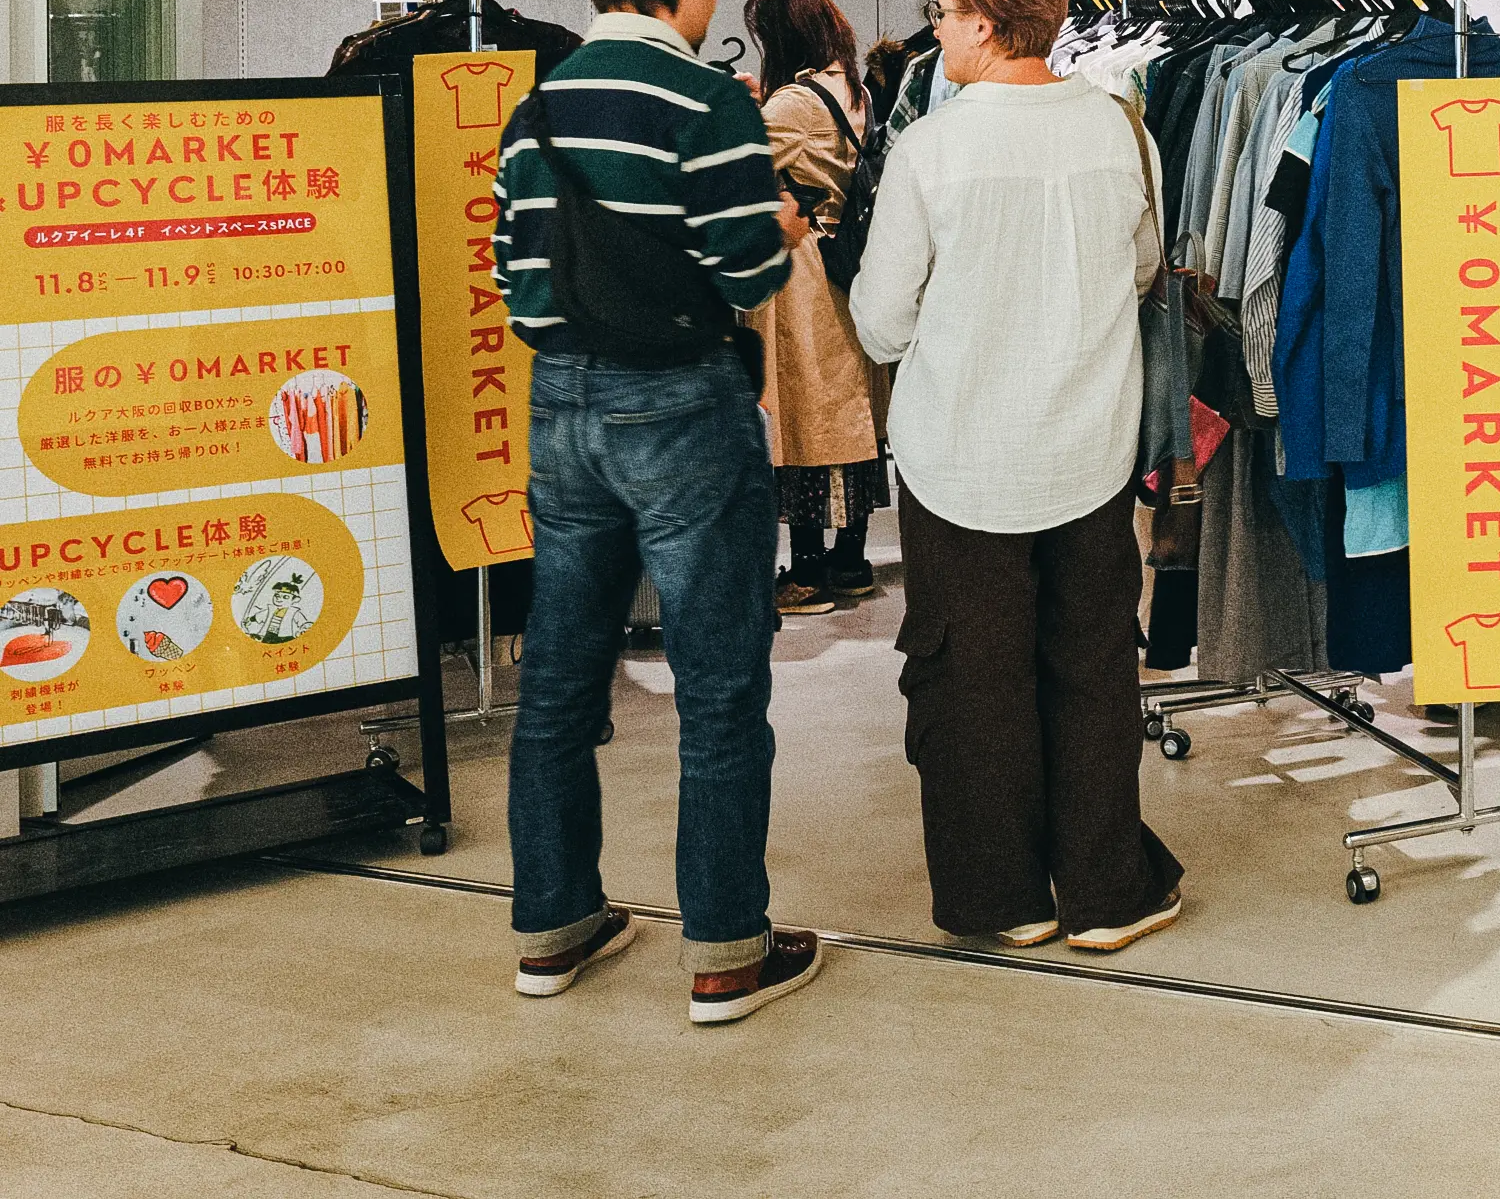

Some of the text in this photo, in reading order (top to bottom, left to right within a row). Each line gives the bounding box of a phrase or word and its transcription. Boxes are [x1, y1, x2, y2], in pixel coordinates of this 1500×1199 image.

[45, 110, 276, 133] 服を長く楽しむための
[0, 166, 341, 212] UPCYCLE体験
[35, 271, 95, 295] 11.8
[97, 271, 108, 292] SAT
[144, 264, 201, 289] 11.9
[206, 262, 215, 285] SUN
[233, 260, 346, 281] 10:30-17:00
[68, 394, 255, 426] ルクア大阪の回収BOXから
[40, 413, 282, 451] 厳選した洋服を、お一人様2点まで
[83, 442, 242, 470] 無料でお持ち帰りOK！
[0, 513, 268, 571] UPCYCLE体験
[0, 538, 312, 589] ッペンや刺繍などで可愛くアップデート体験をご用意！
[262, 643, 311, 660] ペイント
[144, 662, 197, 679] ワッペン
[275, 660, 301, 675] 体験
[10, 679, 80, 701] 刺繍機械が
[159, 680, 185, 694] 体験
[25, 700, 64, 715] 登場！
